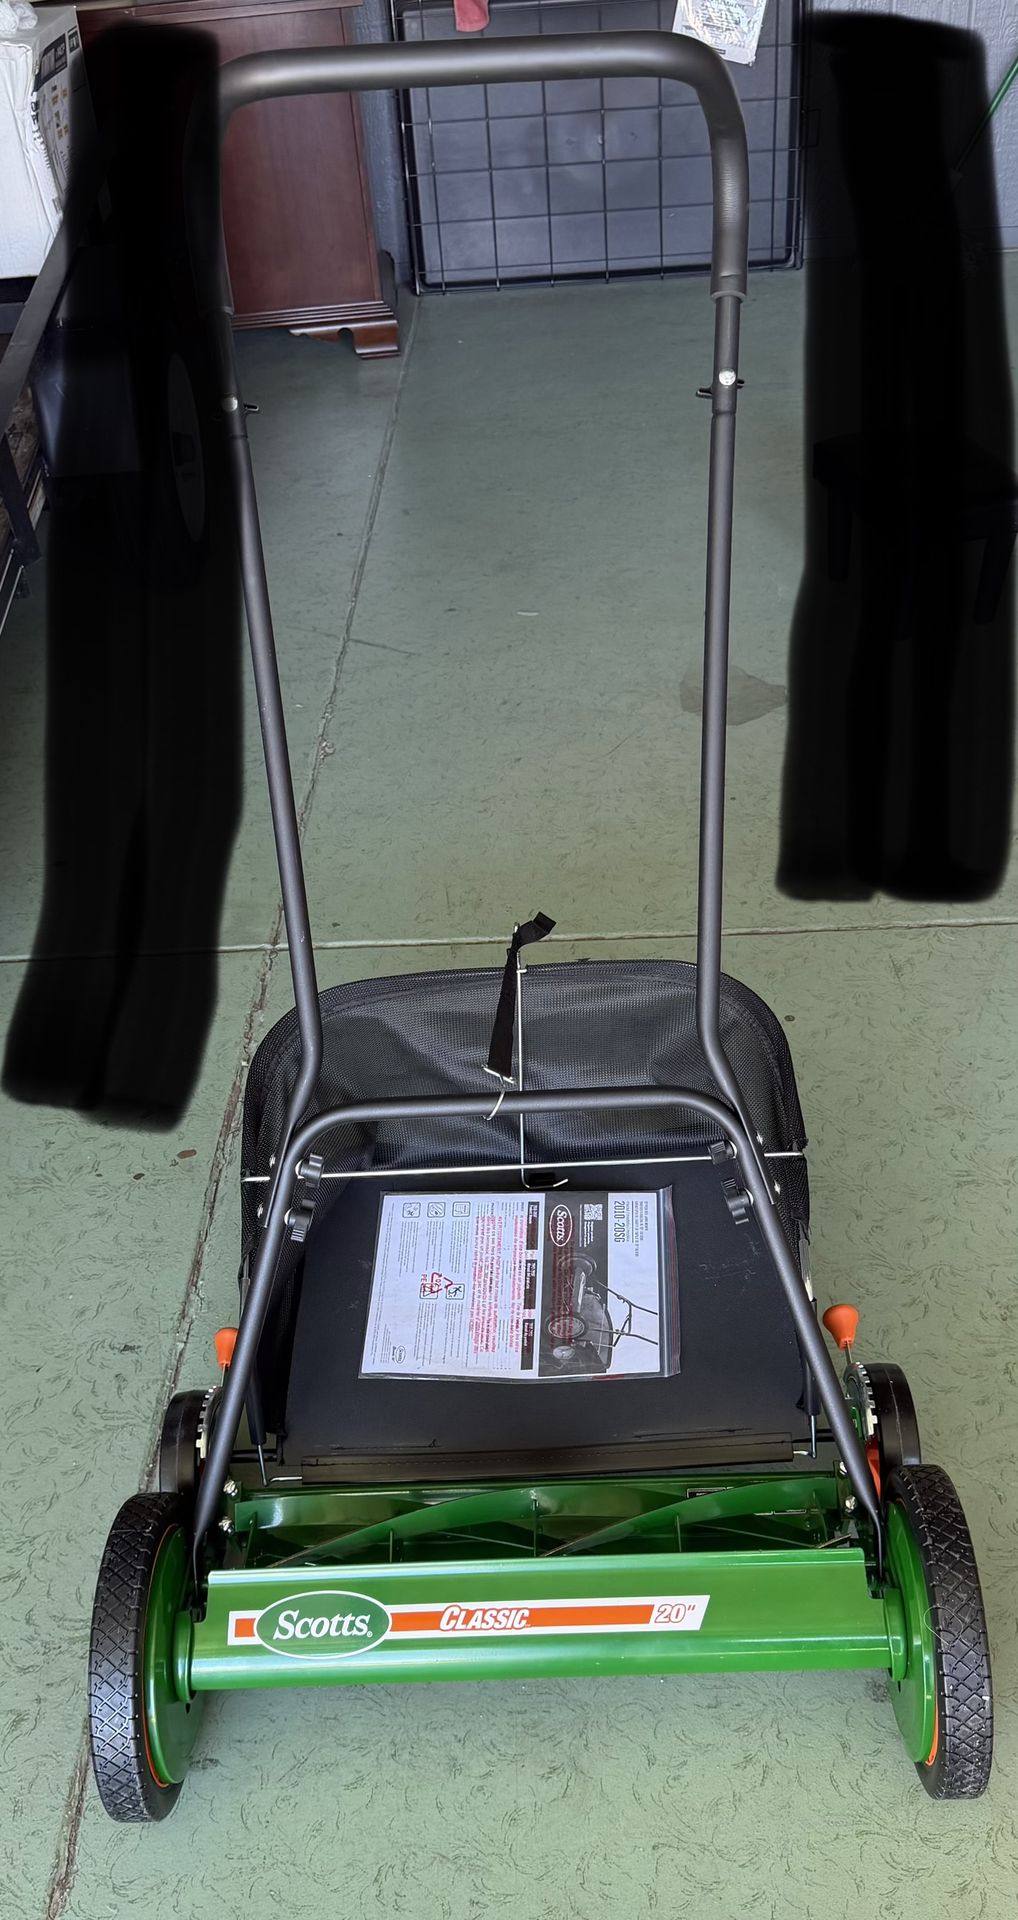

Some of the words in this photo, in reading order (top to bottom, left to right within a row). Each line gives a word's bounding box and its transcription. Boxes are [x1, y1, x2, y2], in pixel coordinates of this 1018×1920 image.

[556, 1209, 568, 1242] Scotts
[614, 1200, 626, 1243] 2010-20SG
[273, 1609, 370, 1640] Scotts
[439, 1604, 530, 1632] CLASSIC
[654, 1603, 697, 1624] 20"
